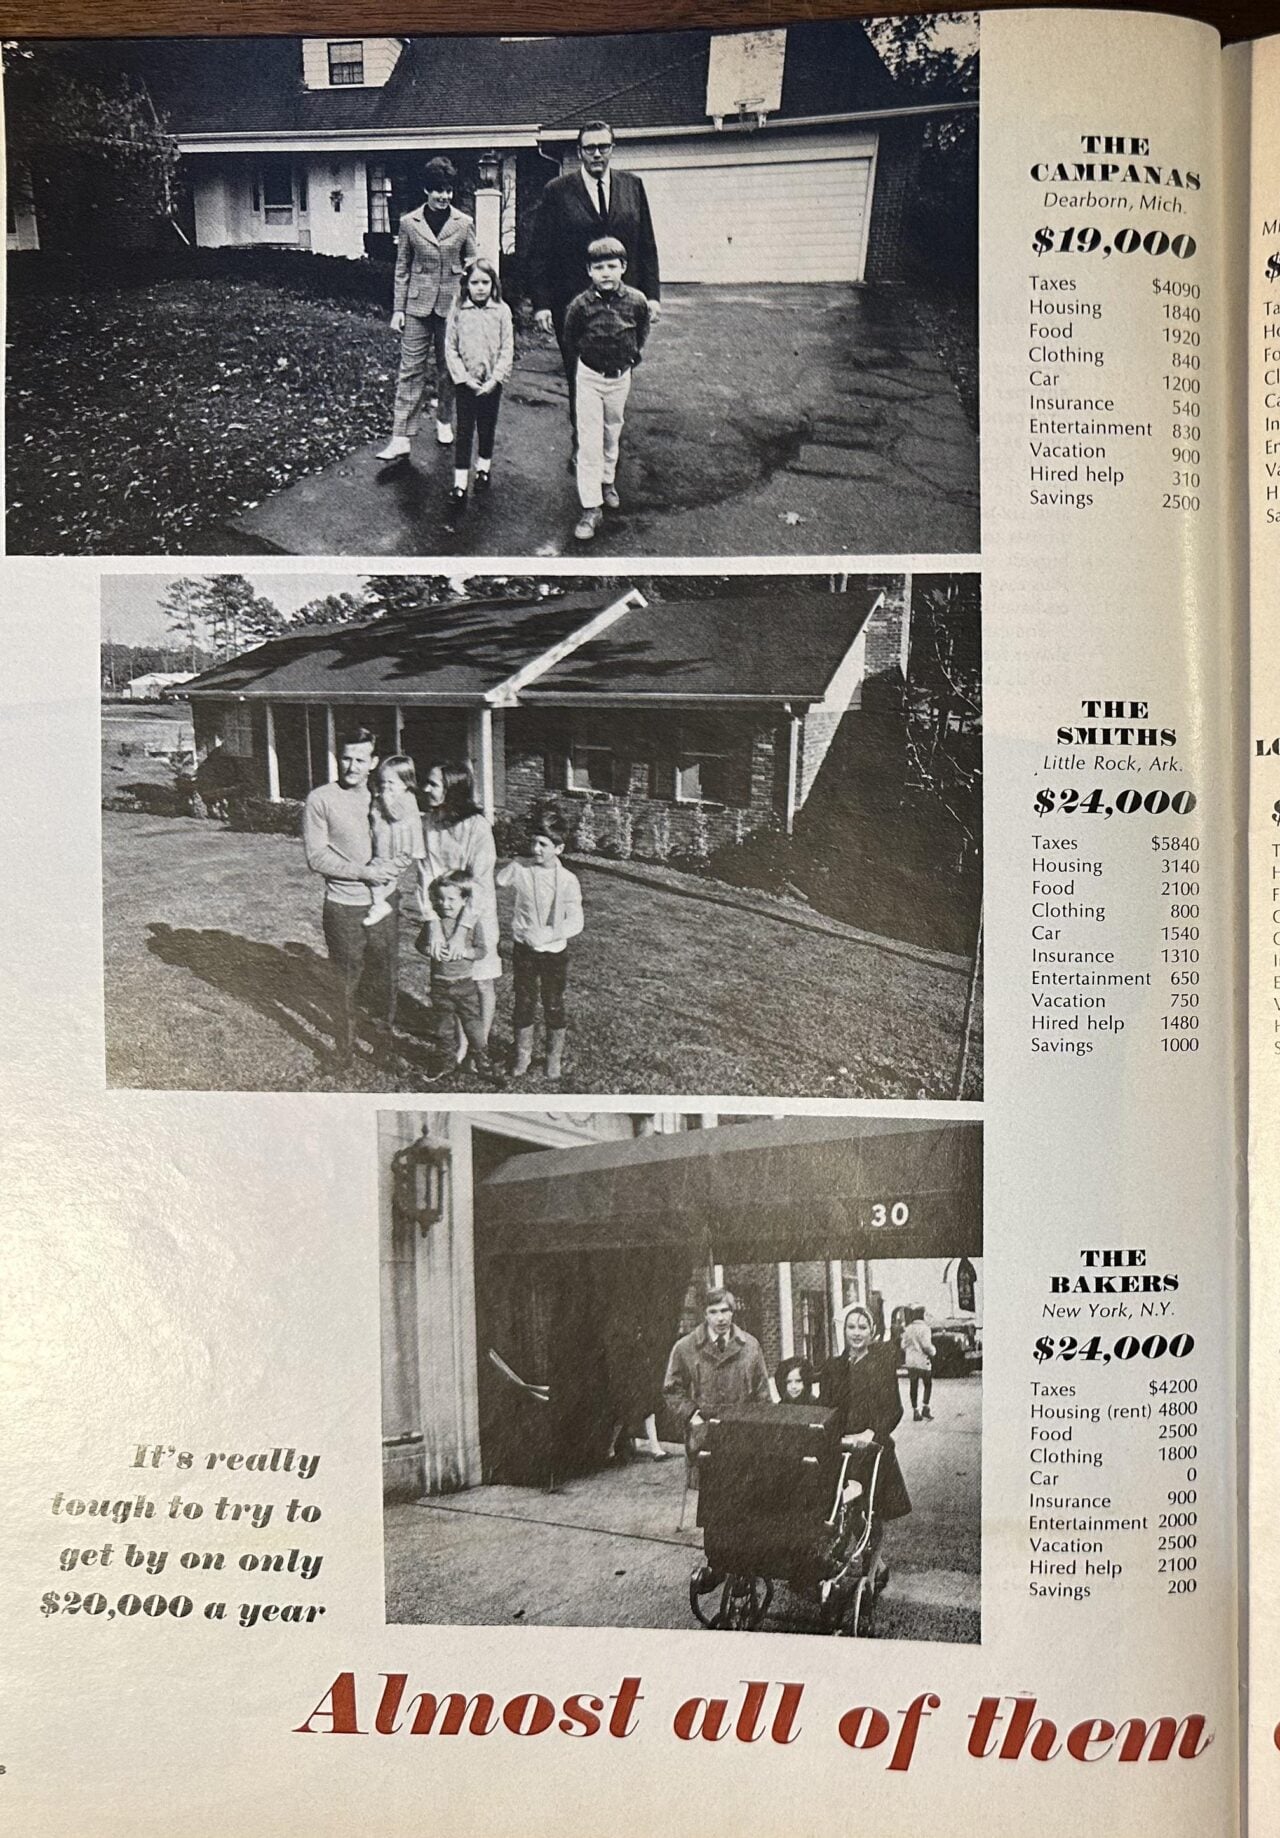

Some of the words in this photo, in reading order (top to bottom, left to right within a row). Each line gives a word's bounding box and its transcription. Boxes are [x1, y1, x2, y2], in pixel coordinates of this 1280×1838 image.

[1081, 135, 1149, 156] THE
[1030, 163, 1201, 190] CAMPANAS
[1044, 190, 1133, 212] Dearborn,
[1139, 195, 1187, 214] Mich.
[1032, 226, 1196, 259] $19,000
[1029, 275, 1076, 291] Taxes
[1153, 278, 1200, 300] $4090
[1029, 345, 1104, 367] Clothing
[1172, 353, 1200, 370] 840
[1030, 415, 1152, 436] Entertainment
[1172, 425, 1200, 441] 830
[1031, 465, 1078, 481] Hired
[1086, 465, 1124, 487] help
[1172, 471, 1200, 488] 310
[1082, 701, 1148, 719] THE
[1057, 727, 1176, 747] SMITHS
[1044, 754, 1085, 770] Little
[1094, 755, 1141, 773] Rock,
[1149, 756, 1183, 775] Ark.
[1034, 787, 1197, 820] $24,000
[1032, 835, 1077, 850] Taxes
[1152, 835, 1200, 852] $5840
[1033, 880, 1074, 895] Food
[1161, 882, 1200, 896] 2100
[1033, 948, 1114, 963] Insurance
[1161, 949, 1199, 963] 1310
[1032, 1015, 1078, 1030] Hired
[1088, 1015, 1124, 1034] help
[1161, 1016, 1199, 1030] 1480
[871, 1202, 909, 1227] 30
[1080, 1249, 1146, 1267] THE
[1049, 1275, 1179, 1293] BAKERS
[1042, 1304, 1081, 1318] New
[1089, 1302, 1132, 1320] York,
[1140, 1301, 1174, 1317] N.Y.
[1033, 1333, 1194, 1366] $24,000
[1031, 1404, 1100, 1423] Housing
[1108, 1403, 1151, 1421] (rent)
[1158, 1401, 1197, 1416] 4800
[129, 1444, 194, 1470] It's
[204, 1448, 321, 1479] really
[1030, 1471, 1059, 1486] Car
[1187, 1467, 1197, 1482] 0
[50, 1492, 157, 1524] tough
[168, 1496, 203, 1520] to
[214, 1497, 274, 1528] try
[286, 1499, 322, 1523] to
[1030, 1537, 1102, 1554] Vacation
[1158, 1534, 1197, 1551] 2500
[60, 1544, 115, 1572] get
[124, 1544, 169, 1575] by
[180, 1552, 226, 1571] on
[239, 1549, 324, 1580] only
[40, 1591, 193, 1621] $20,000
[204, 1602, 227, 1620] a
[237, 1604, 326, 1628] year
[292, 1672, 644, 1738] Almost
[674, 1680, 805, 1744] all
[839, 1693, 941, 1772] of
[968, 1691, 1215, 1762] them
